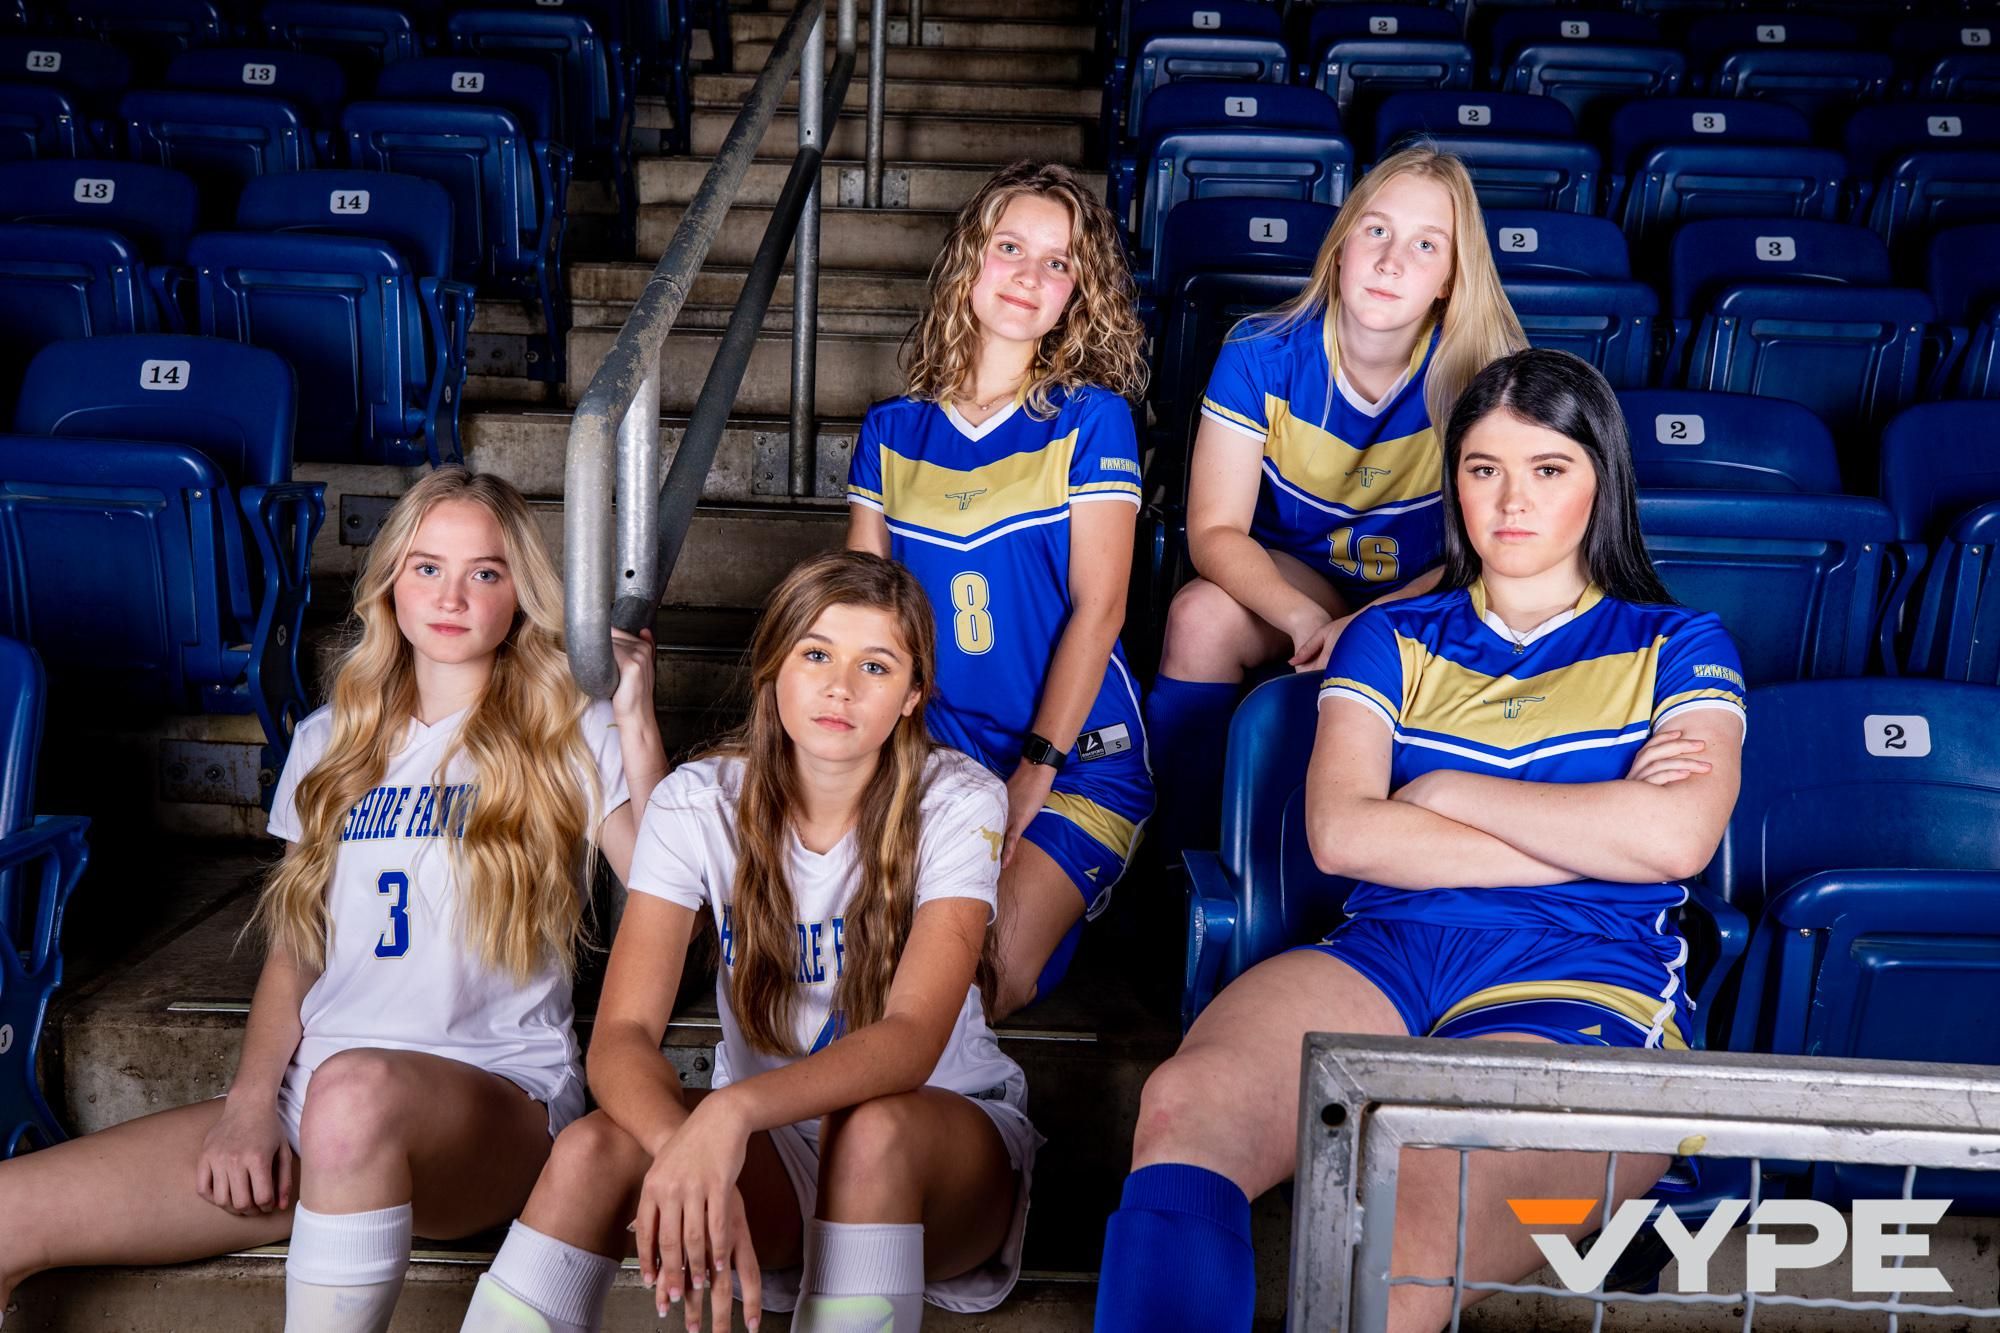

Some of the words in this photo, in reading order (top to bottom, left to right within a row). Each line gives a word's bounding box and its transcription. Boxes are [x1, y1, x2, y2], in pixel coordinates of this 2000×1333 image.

[1202, 15, 1210, 26] 1
[1378, 20, 1388, 32] 2
[1570, 24, 1579, 35] 3
[1765, 29, 1776, 39] 4
[1970, 32, 1980, 43] 5
[32, 55, 56, 69] 12
[248, 67, 271, 81] 13
[457, 76, 478, 89] 14
[1237, 101, 1246, 113] 1
[1468, 109, 1480, 122] 2
[1703, 116, 1715, 129] 3
[1938, 120, 1950, 132] 4
[81, 183, 108, 199] 13
[337, 195, 362, 210] 14
[1263, 222, 1274, 238] 1
[1511, 232, 1526, 248] 2
[1768, 241, 1783, 257] 3
[149, 365, 180, 384] 14
[1670, 420, 1687, 439] 2
[1327, 527, 1399, 582] 16
[950, 571, 995, 655] 8
[1883, 723, 1907, 750] 2
[1115, 740, 1122, 749] S
[339, 786, 412, 841] SHIRE
[374, 869, 412, 960] 3
